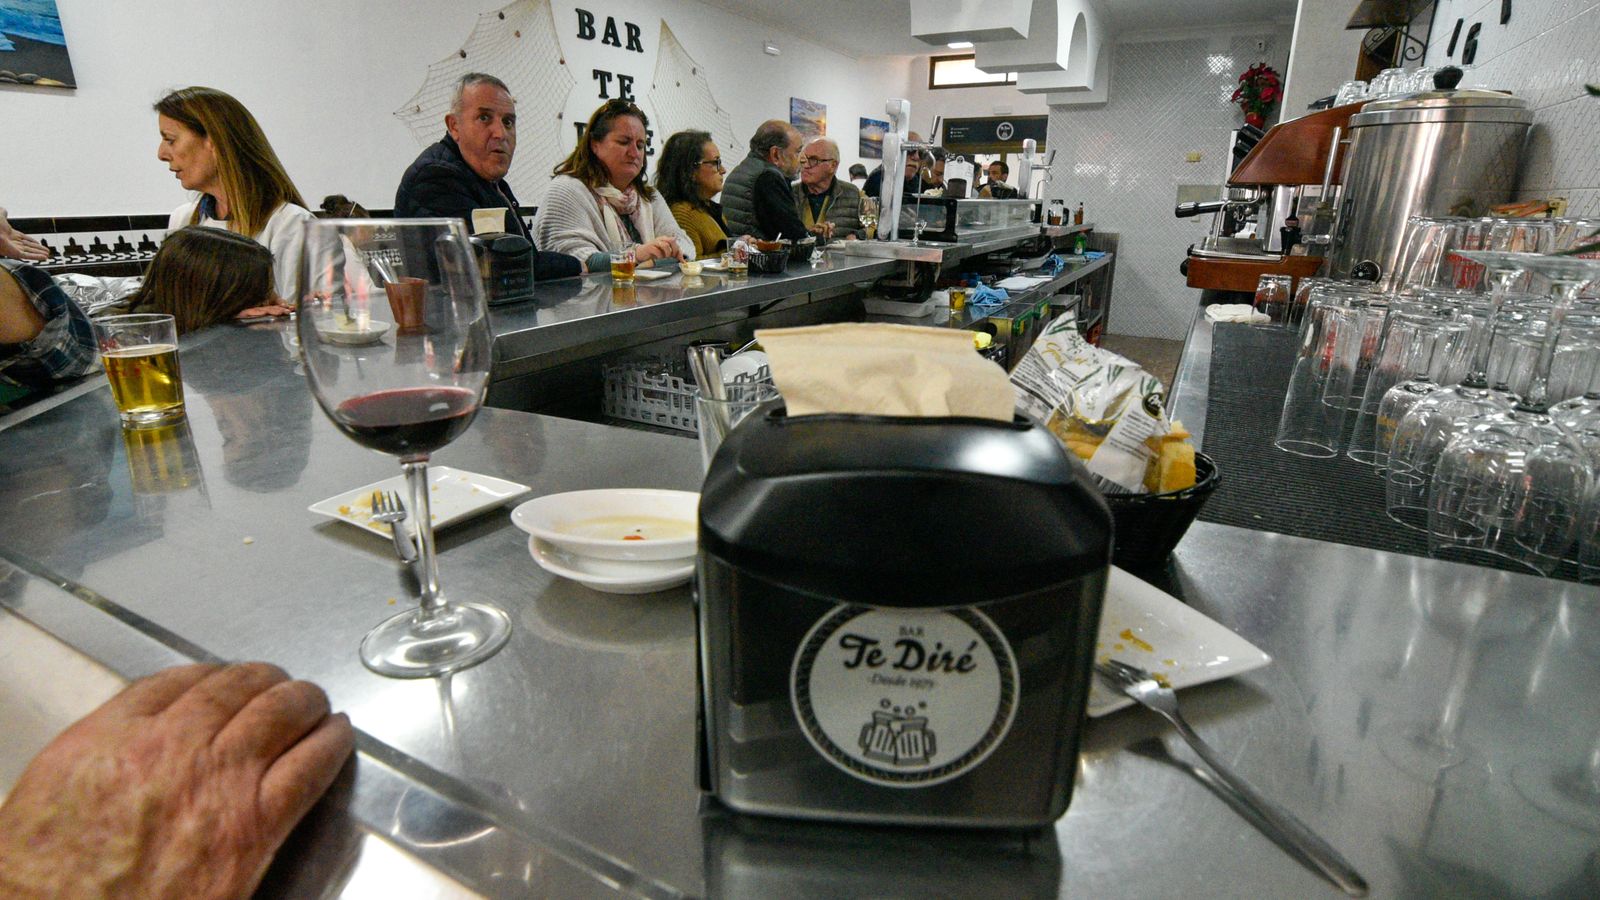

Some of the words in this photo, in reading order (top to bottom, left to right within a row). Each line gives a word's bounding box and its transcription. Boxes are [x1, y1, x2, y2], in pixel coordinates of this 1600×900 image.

[575, 7, 644, 53] BAR
[592, 69, 635, 102] TE
[839, 633, 886, 668] Te
[893, 638, 977, 673] Diré
